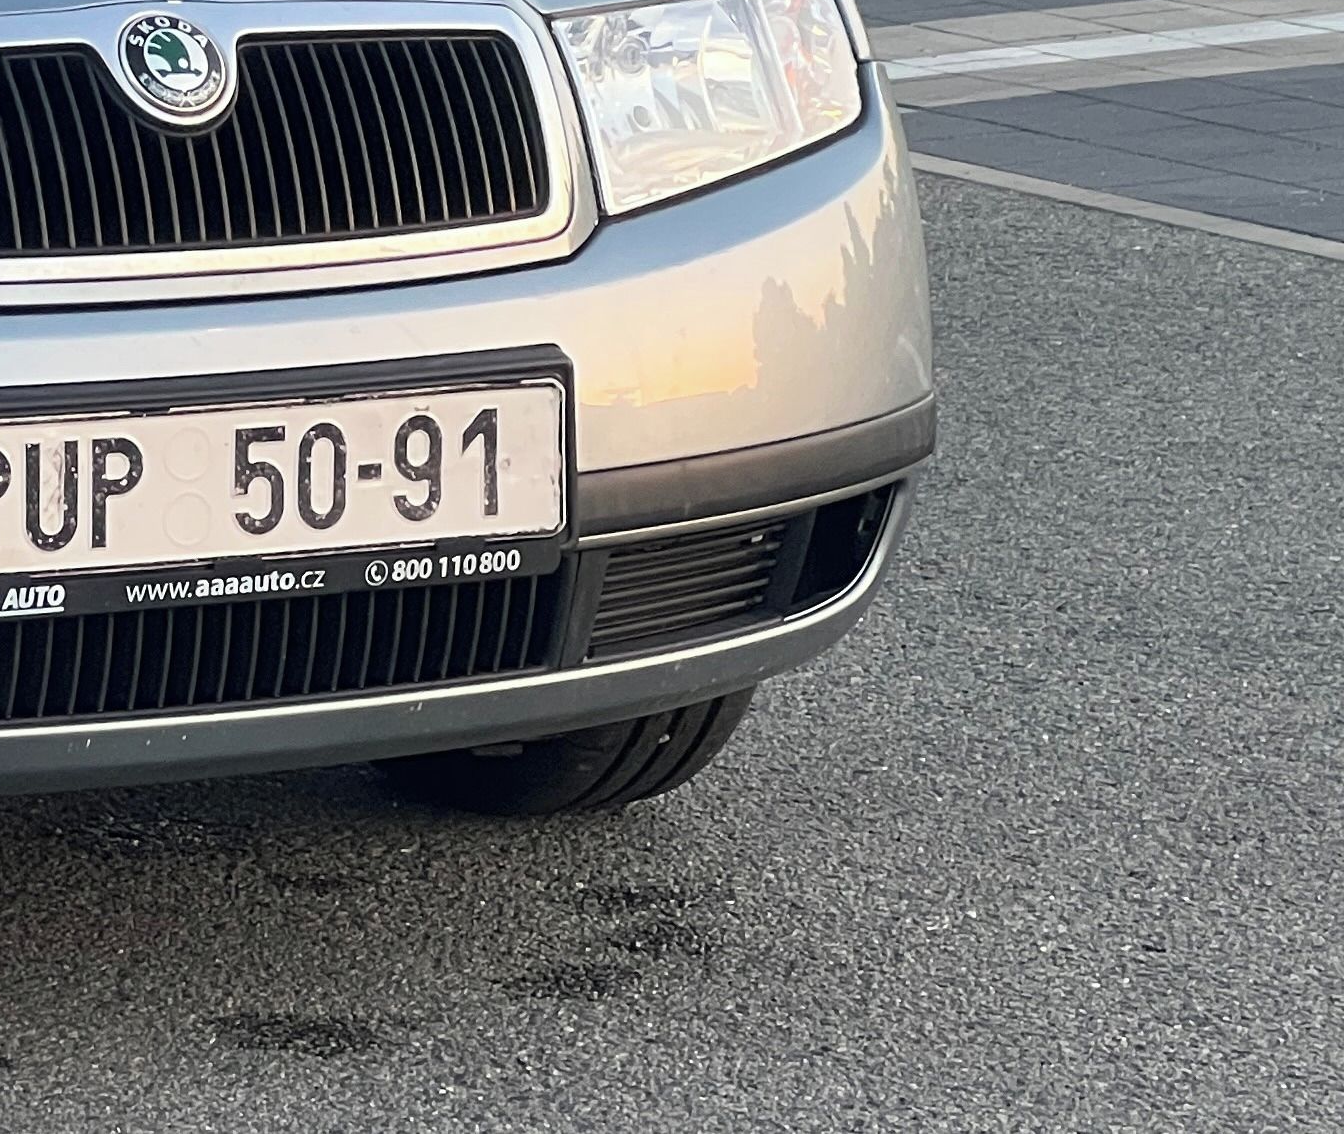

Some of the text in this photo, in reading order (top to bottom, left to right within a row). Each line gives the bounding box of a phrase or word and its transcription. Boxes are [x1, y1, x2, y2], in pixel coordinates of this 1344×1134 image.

[234, 408, 499, 536] 50-91
[391, 549, 521, 582] 800 110 800
[1, 584, 66, 611] AUTO
[125, 569, 326, 603] www.aaaauto.cz
